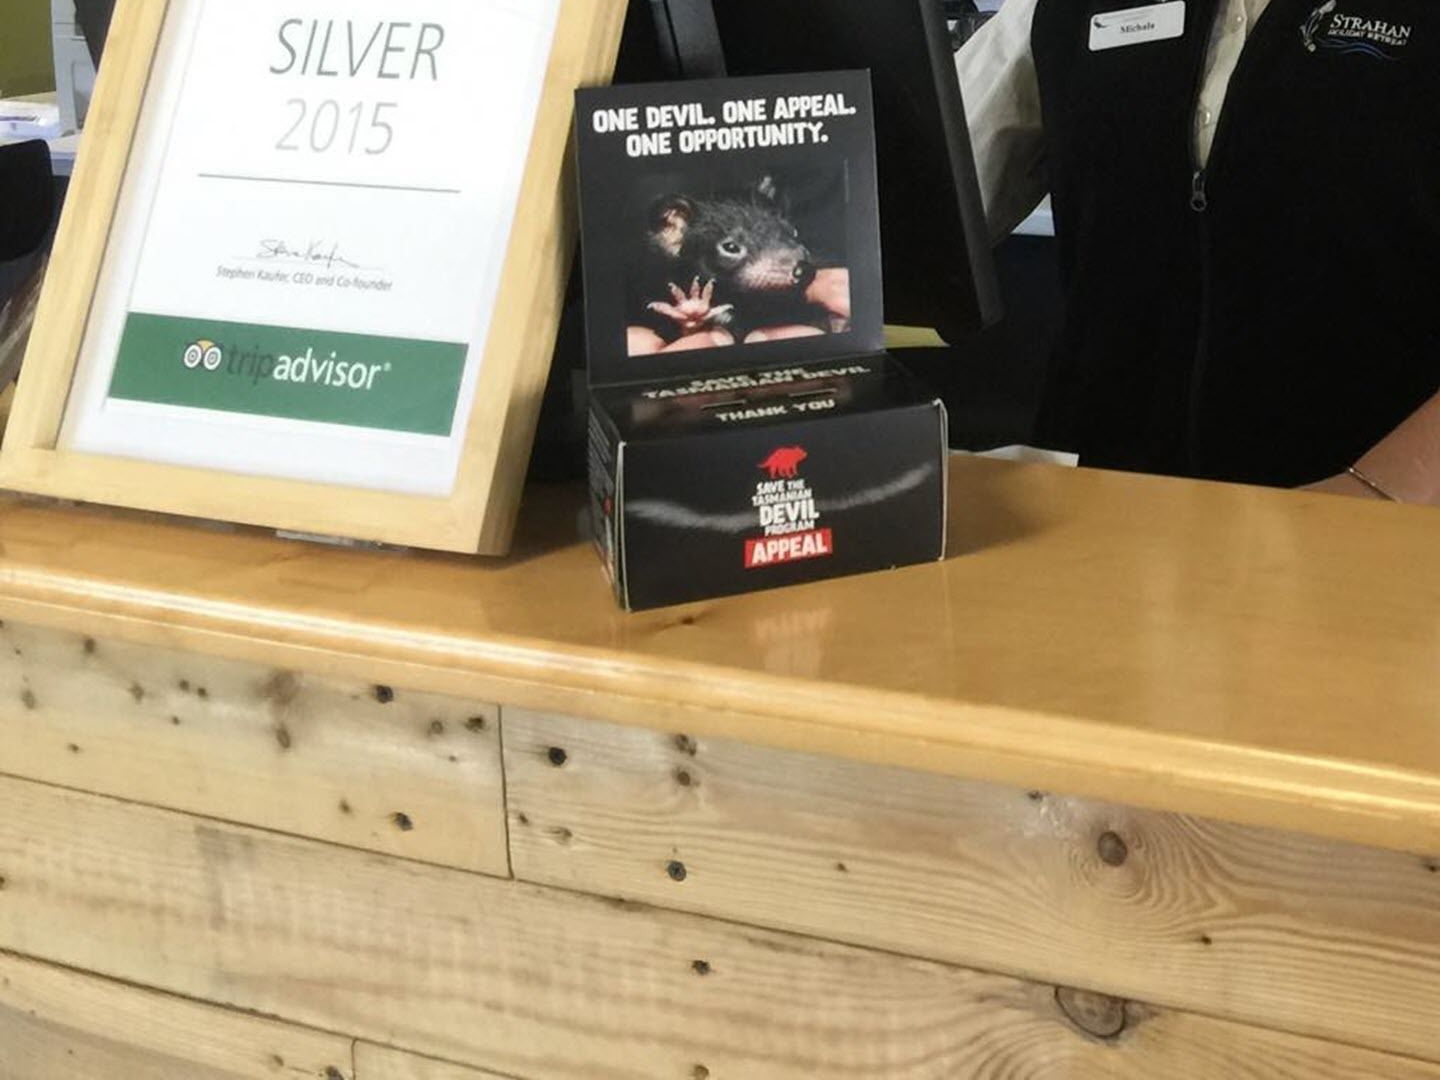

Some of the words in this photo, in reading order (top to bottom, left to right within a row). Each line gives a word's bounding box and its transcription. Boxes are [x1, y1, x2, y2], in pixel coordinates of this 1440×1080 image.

[1330, 13, 1411, 38] STRAHAN
[269, 19, 445, 80] SILVER
[593, 108, 638, 133] ONE
[646, 104, 716, 128] DEVIL.
[722, 100, 767, 123] ONE
[773, 93, 857, 119] APPEAL.
[275, 99, 398, 155] 2015
[626, 134, 672, 157] ONE
[679, 121, 829, 153] OPPORTUNITY.
[216, 265, 256, 280] Stephen
[292, 272, 313, 284] CEO
[315, 274, 335, 286] and
[336, 276, 393, 291] Co-founder
[802, 365, 872, 380] DEVIL
[715, 405, 788, 422] THANK
[793, 398, 836, 413] YOU
[752, 487, 813, 507] TASMANIAN
[756, 479, 785, 495] SAVE
[787, 478, 806, 490] THE
[759, 498, 820, 526] DEVIL
[764, 520, 815, 537] PROGRAM
[752, 532, 829, 564] APPEAL
